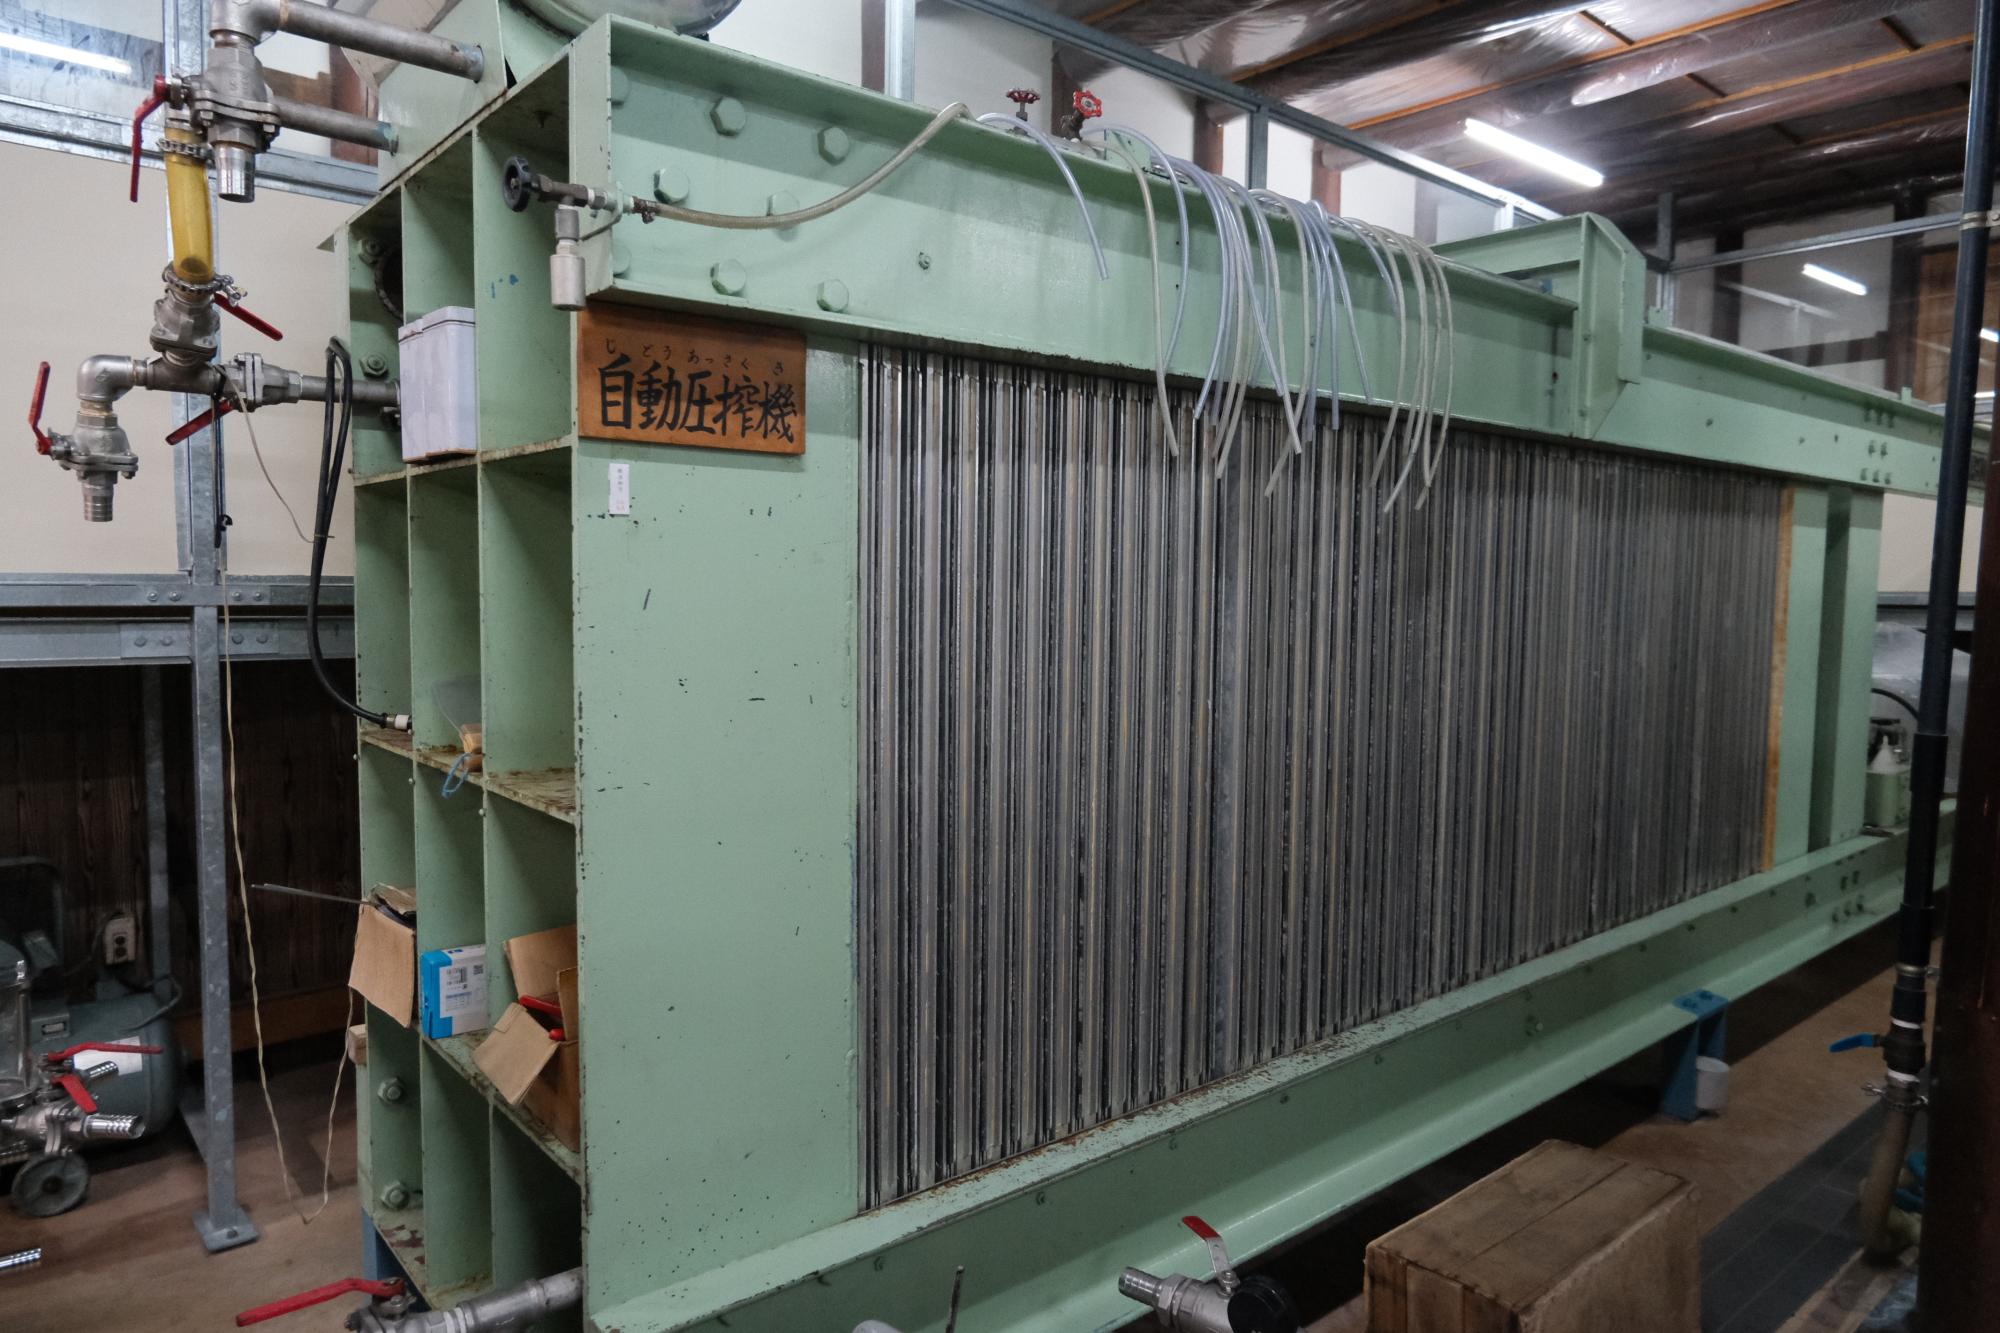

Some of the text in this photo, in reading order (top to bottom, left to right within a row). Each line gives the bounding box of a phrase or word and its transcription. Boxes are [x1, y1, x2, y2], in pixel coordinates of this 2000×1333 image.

[597, 352, 799, 444] 自動圧搾機
